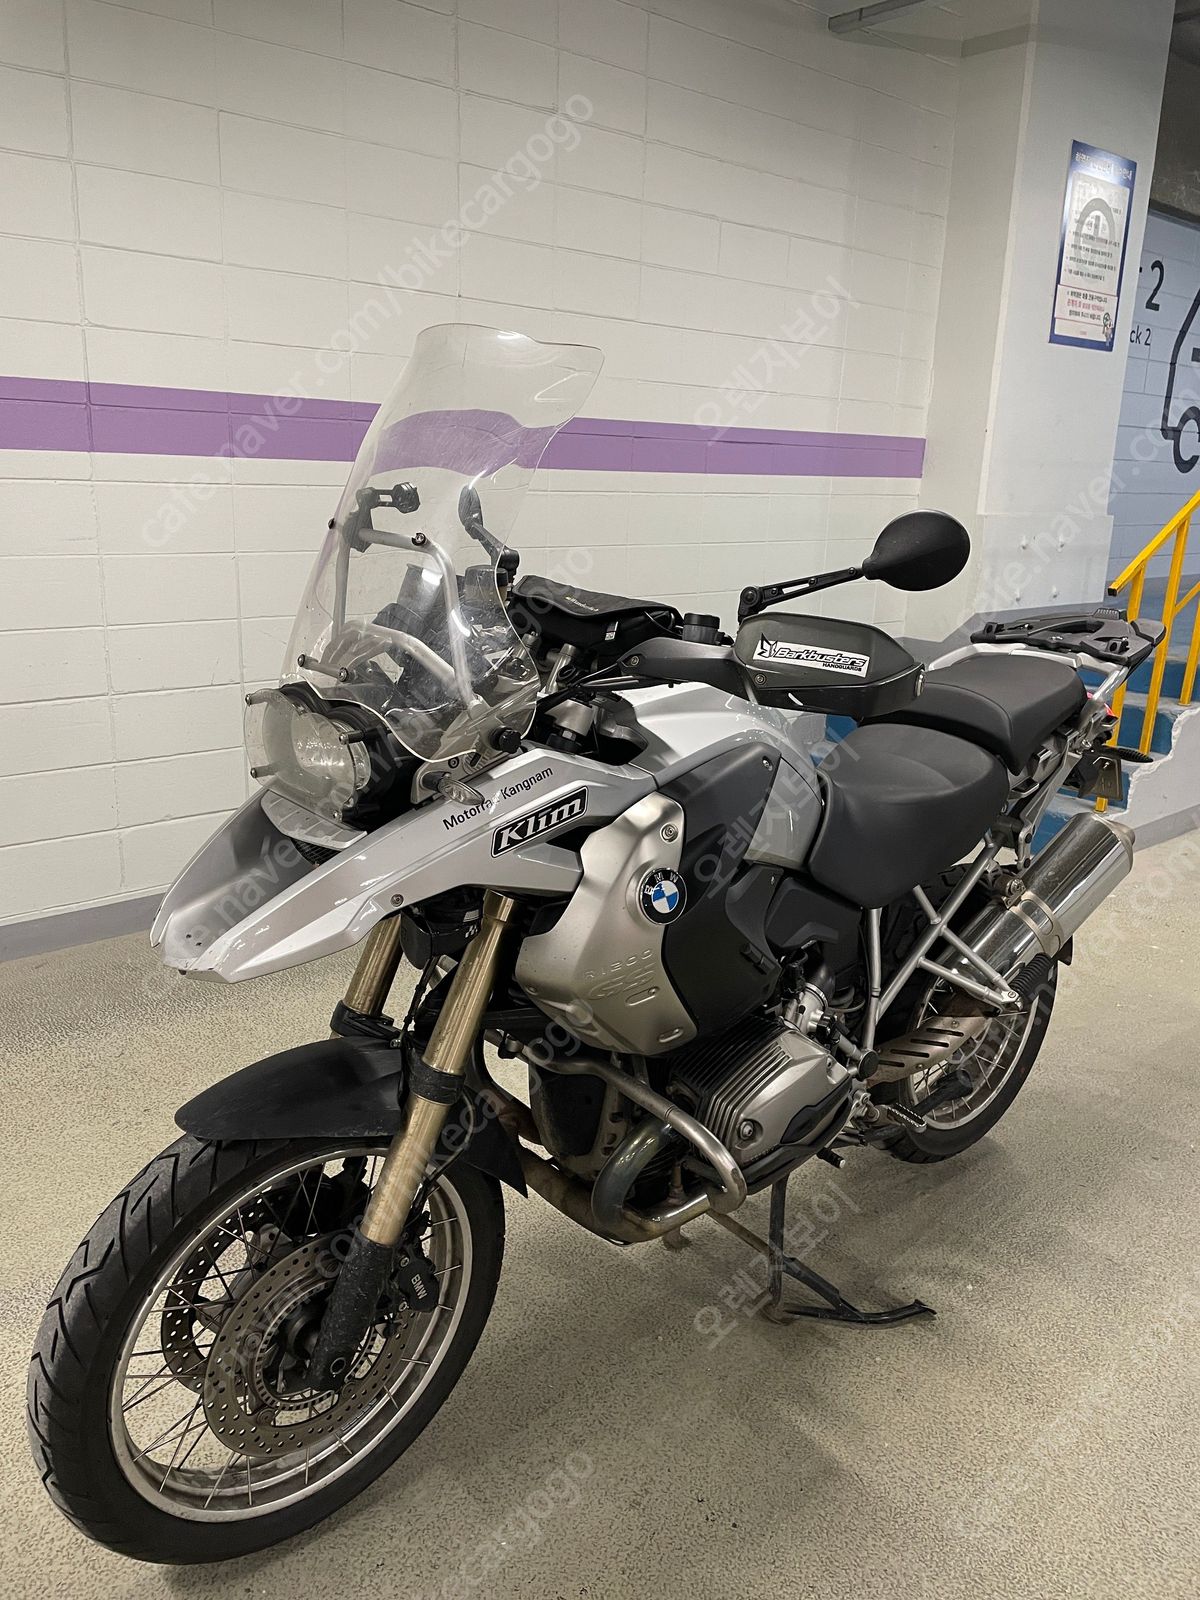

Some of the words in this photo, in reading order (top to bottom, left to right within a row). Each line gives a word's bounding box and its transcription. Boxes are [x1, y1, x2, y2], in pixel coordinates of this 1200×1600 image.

[1145, 260, 1164, 311] 2
[1144, 328, 1151, 345] 2
[772, 648, 868, 667] Barkbusters
[501, 767, 553, 800] Kangnam
[644, 872, 679, 895] BMW
[411, 1274, 428, 1299] BMW
